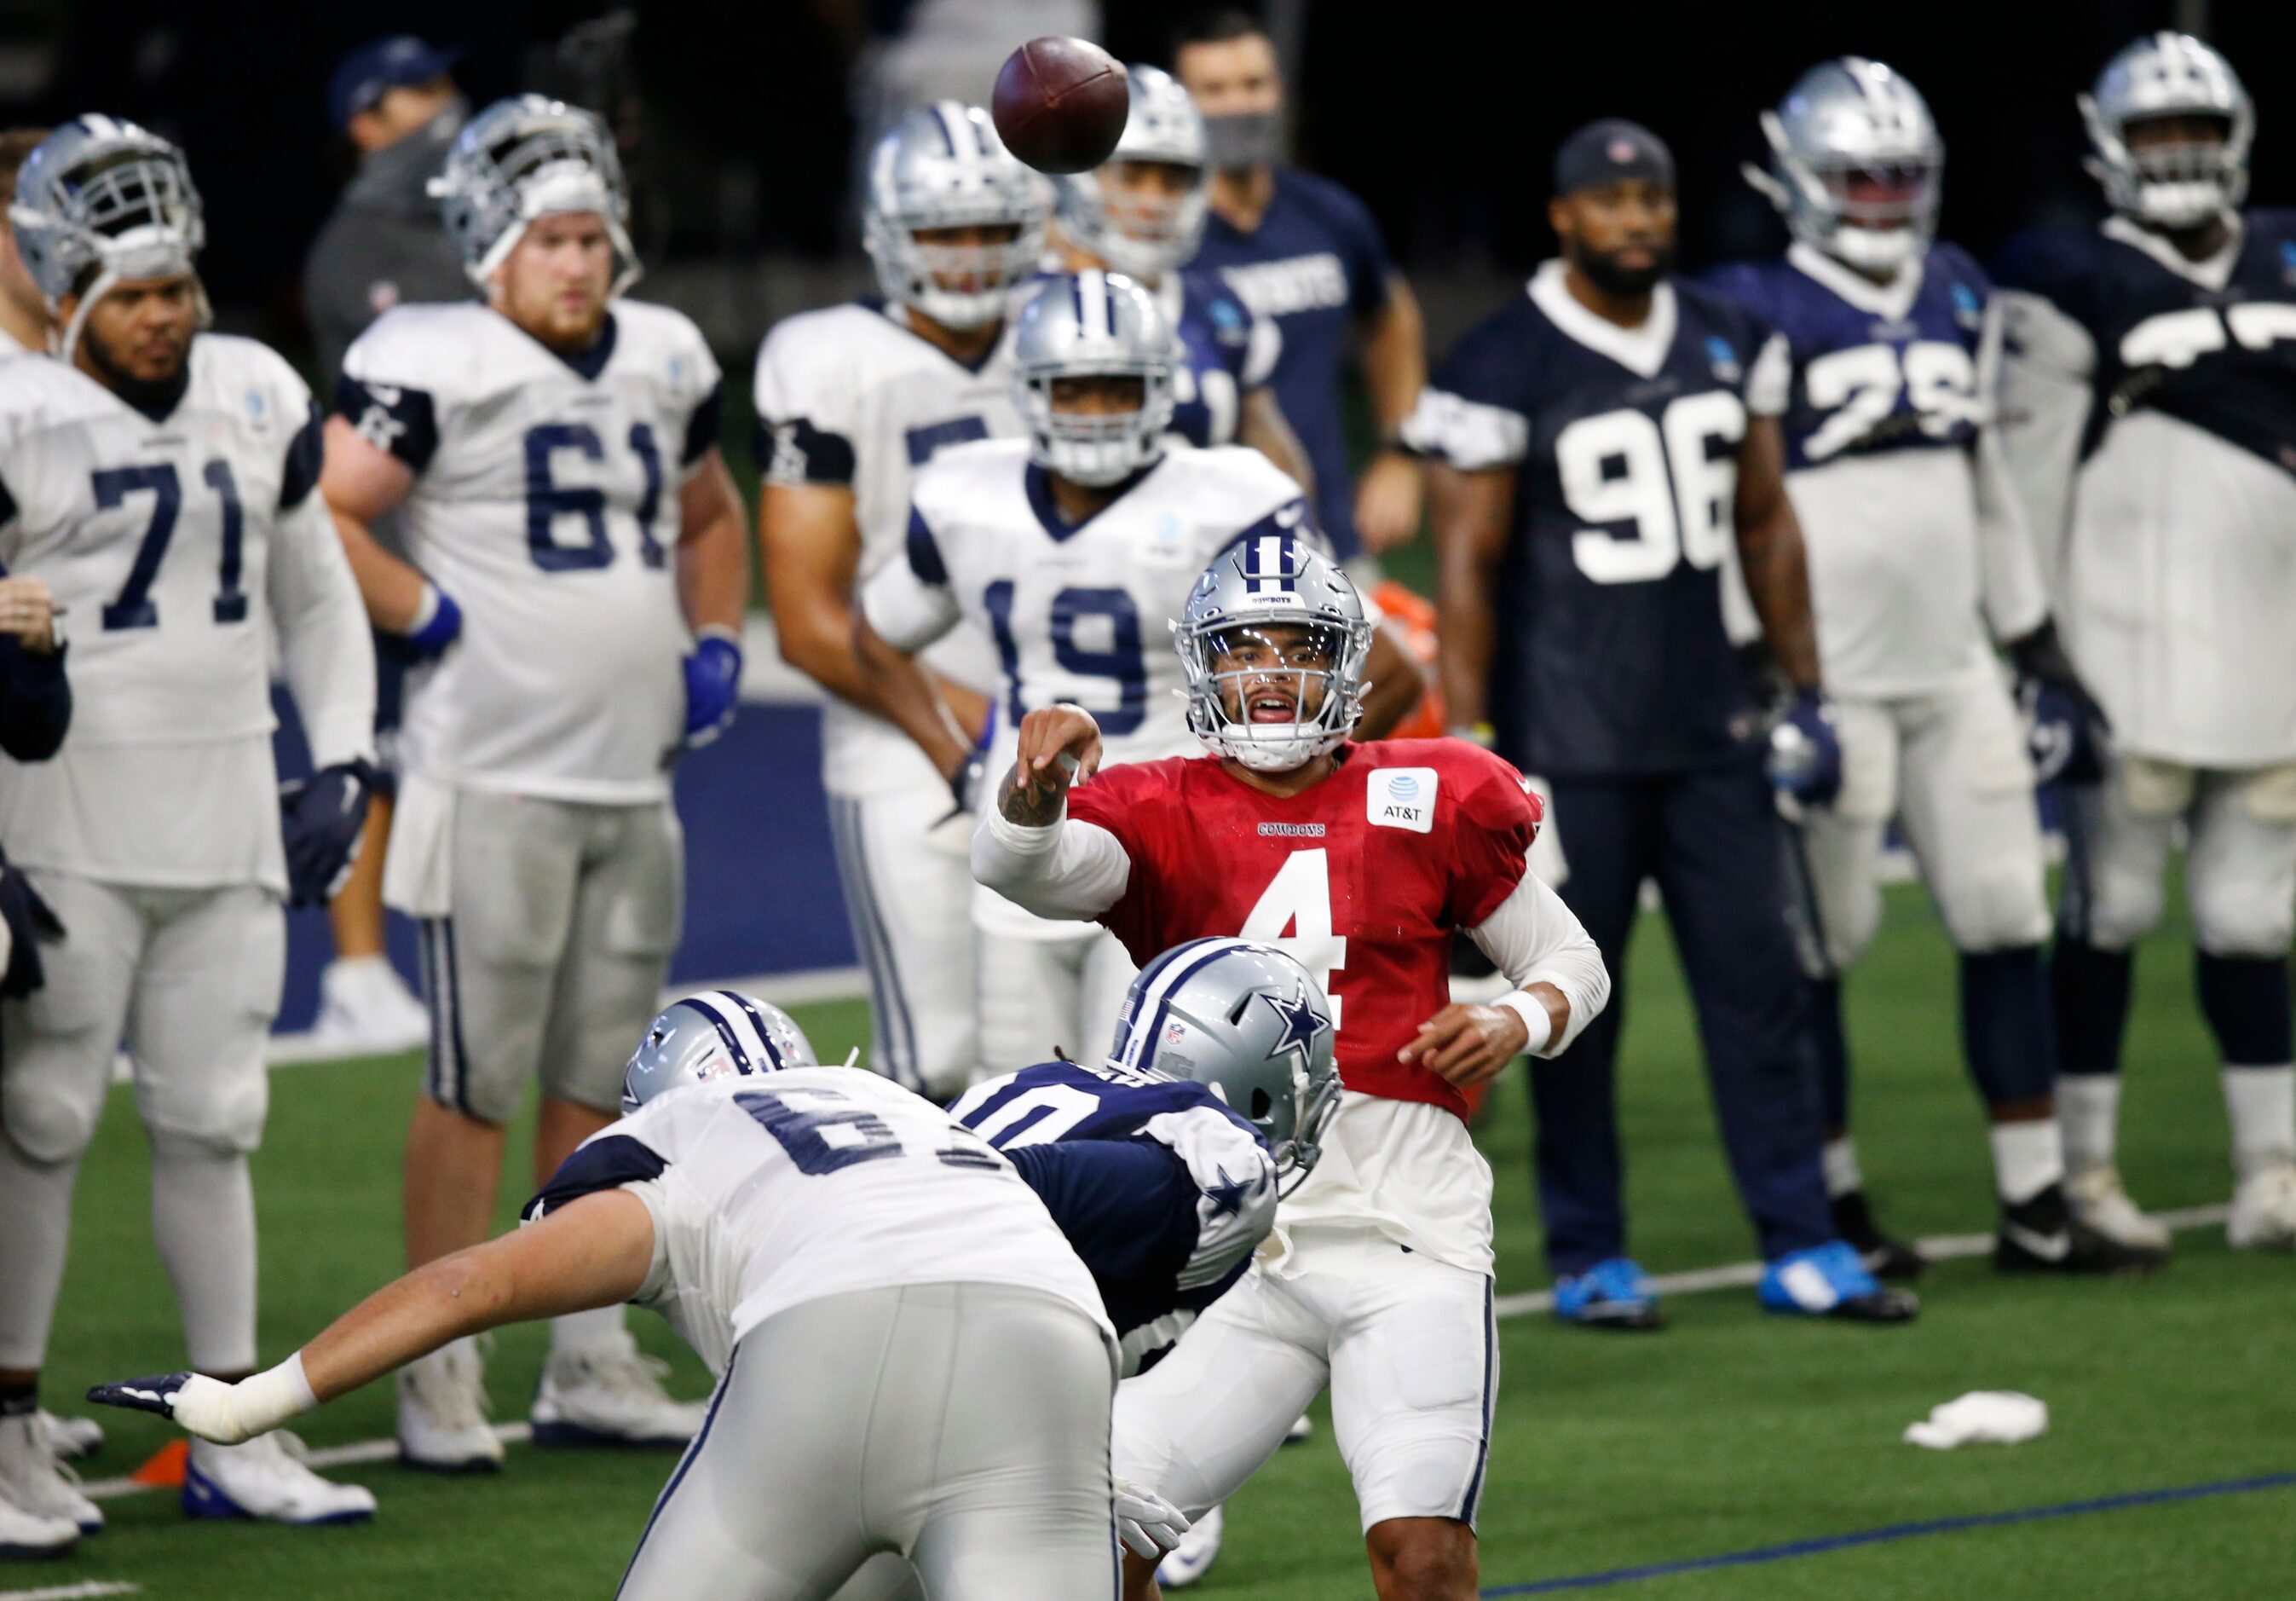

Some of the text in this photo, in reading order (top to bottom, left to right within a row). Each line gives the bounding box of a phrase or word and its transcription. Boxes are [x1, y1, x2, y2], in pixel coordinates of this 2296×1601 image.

[90, 458, 248, 631] 71
[524, 421, 666, 574] 61
[1555, 389, 1746, 586] 96
[984, 580, 1148, 737] 19
[1257, 822, 1326, 837] COWBOYS
[1383, 805, 1422, 822] AT&T
[1238, 847, 1347, 1032] 4
